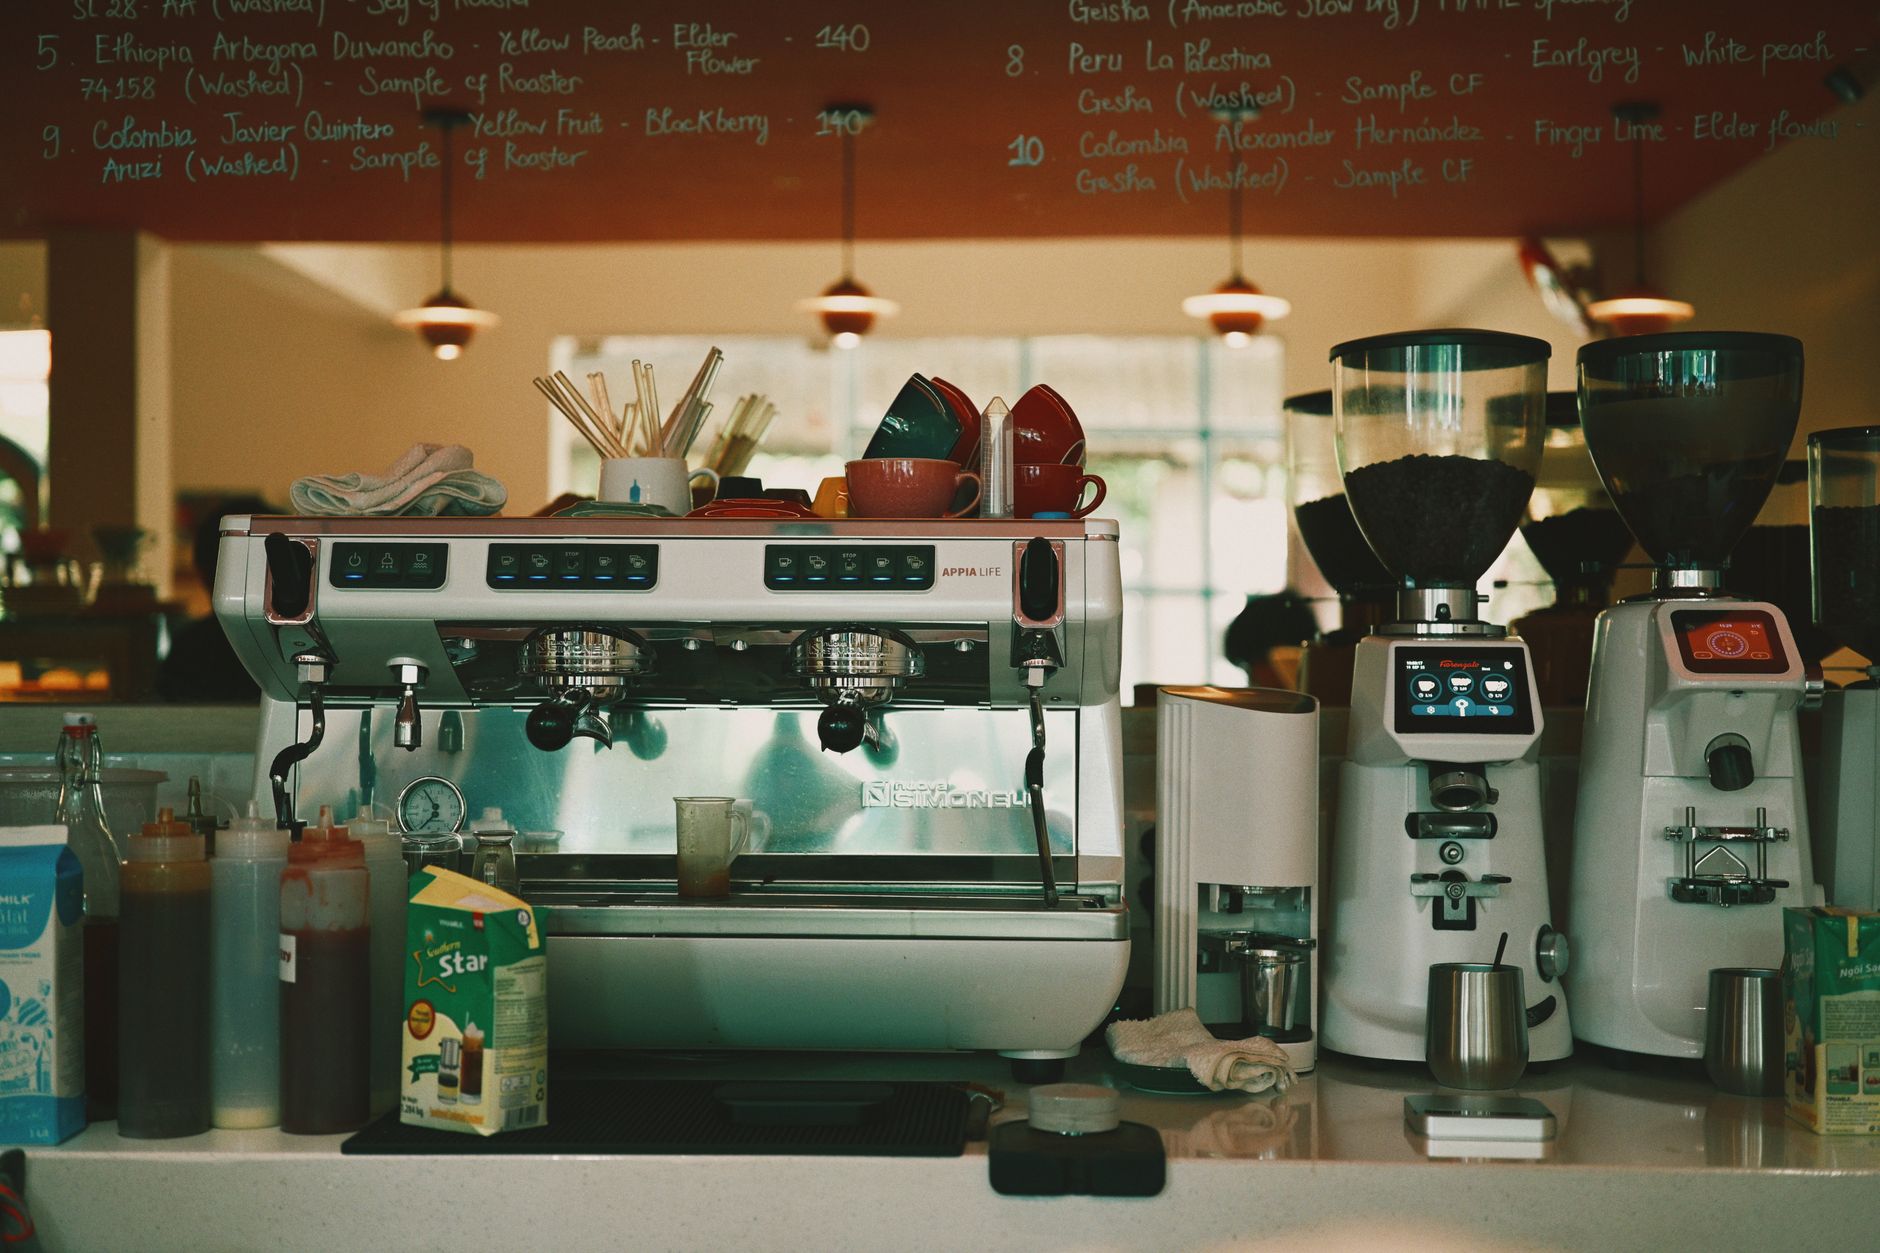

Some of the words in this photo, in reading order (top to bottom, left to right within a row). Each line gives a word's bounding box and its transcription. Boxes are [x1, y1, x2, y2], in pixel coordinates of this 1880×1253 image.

[1068, 0, 1150, 24] Geisha
[1168, 0, 1288, 29] (Anaerobic
[95, 33, 193, 71] Ethiopia
[213, 32, 317, 74] Arbegona
[333, 29, 454, 60] Duwancho
[500, 29, 569, 54] Yellow
[584, 24, 645, 54] Peach
[673, 24, 738, 49] Elder
[816, 24, 870, 52] 140
[686, 50, 760, 75] Flower
[1068, 42, 1122, 74] Peru
[1146, 39, 1174, 71] La
[1184, 38, 1272, 72] Palestina
[1532, 38, 1641, 83] Earlgrey
[1681, 31, 1755, 67] White
[1762, 32, 1835, 78] peach
[81, 76, 156, 102] 74158
[359, 67, 452, 110] Sample
[499, 62, 584, 94] Roaster
[1078, 85, 1153, 114] Gesha
[1342, 71, 1437, 113] Sample
[1450, 73, 1485, 96] CF
[93, 115, 197, 149] Colombia
[221, 111, 297, 144] Javier
[304, 110, 394, 142] Quintero
[468, 111, 547, 138] Yellow
[557, 108, 604, 136] Fruit
[815, 110, 867, 137] 140
[1080, 129, 1189, 159] Colombia
[1215, 119, 1336, 153] Alexander
[1535, 119, 1602, 158] Finger
[1614, 115, 1668, 142] Lime
[1694, 111, 1758, 141] Elder
[350, 142, 441, 183] Sample
[505, 141, 588, 171] Roaster
[1334, 156, 1425, 198] Sample
[1442, 158, 1474, 183] CF
[942, 567, 977, 577] APPIA
[979, 567, 1001, 577] LIFE
[894, 782, 950, 792] nuova
[439, 951, 488, 978] Star
